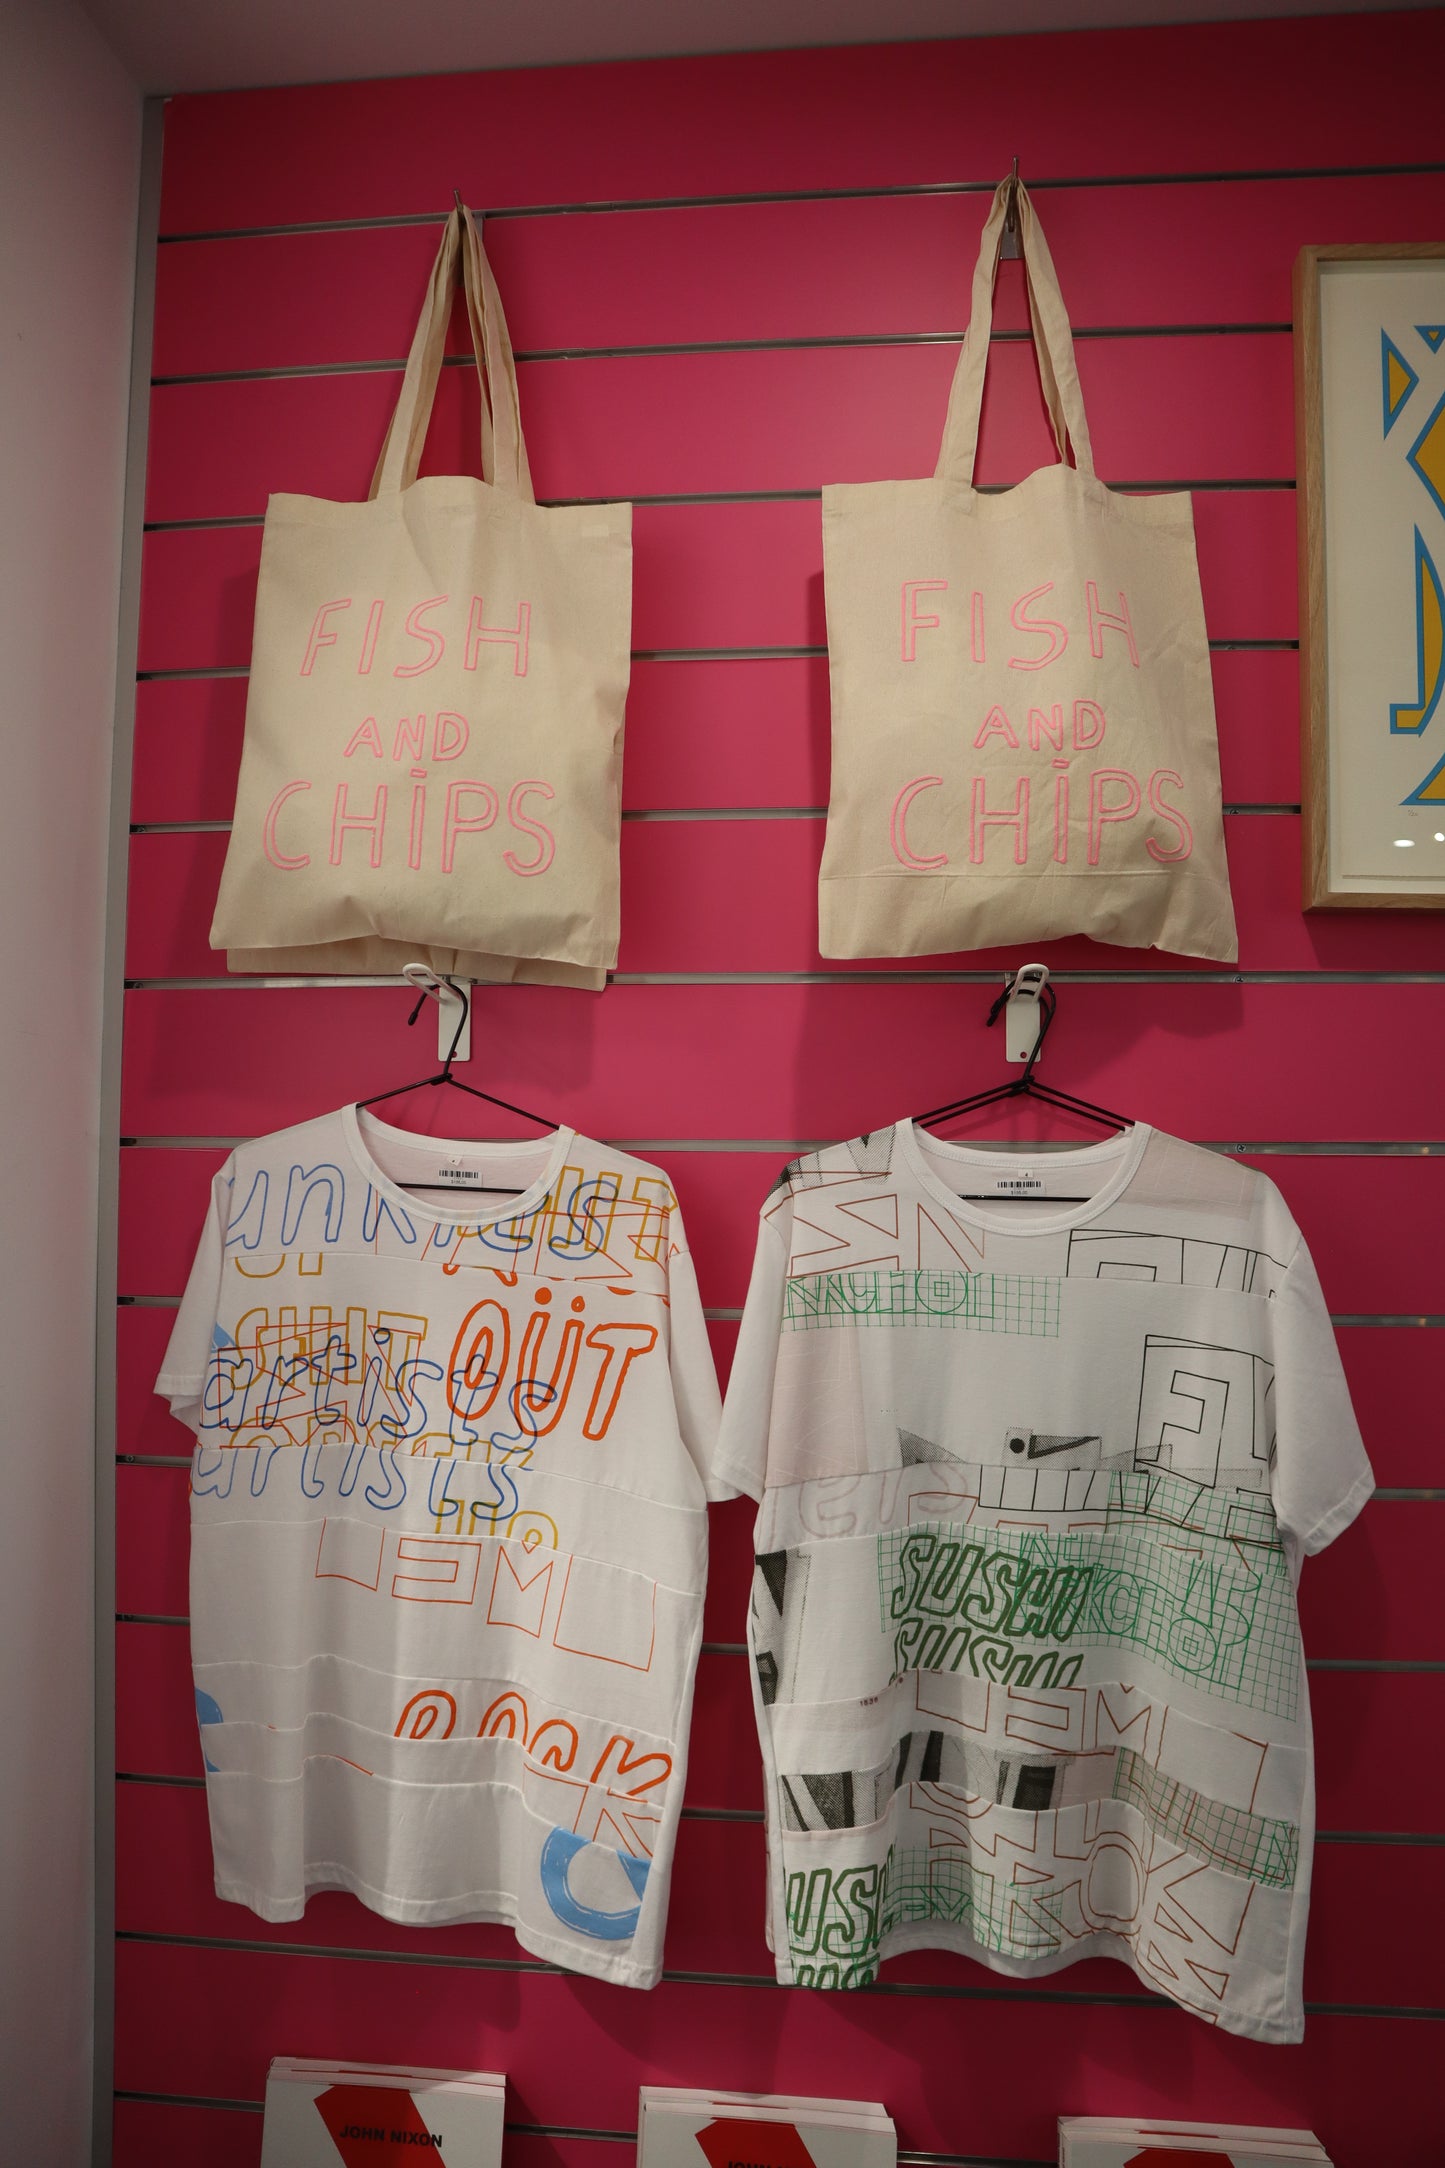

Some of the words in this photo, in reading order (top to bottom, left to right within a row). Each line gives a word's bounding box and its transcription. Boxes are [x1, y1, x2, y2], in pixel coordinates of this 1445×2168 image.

[301, 595, 532, 677] FISH
[901, 578, 1140, 671] FISH
[343, 711, 470, 761] AND
[973, 700, 1106, 751] AND
[889, 1534, 1095, 1643] SUSHI
[340, 2125, 385, 2141] JOHN
[390, 2130, 443, 2148] NIXON
